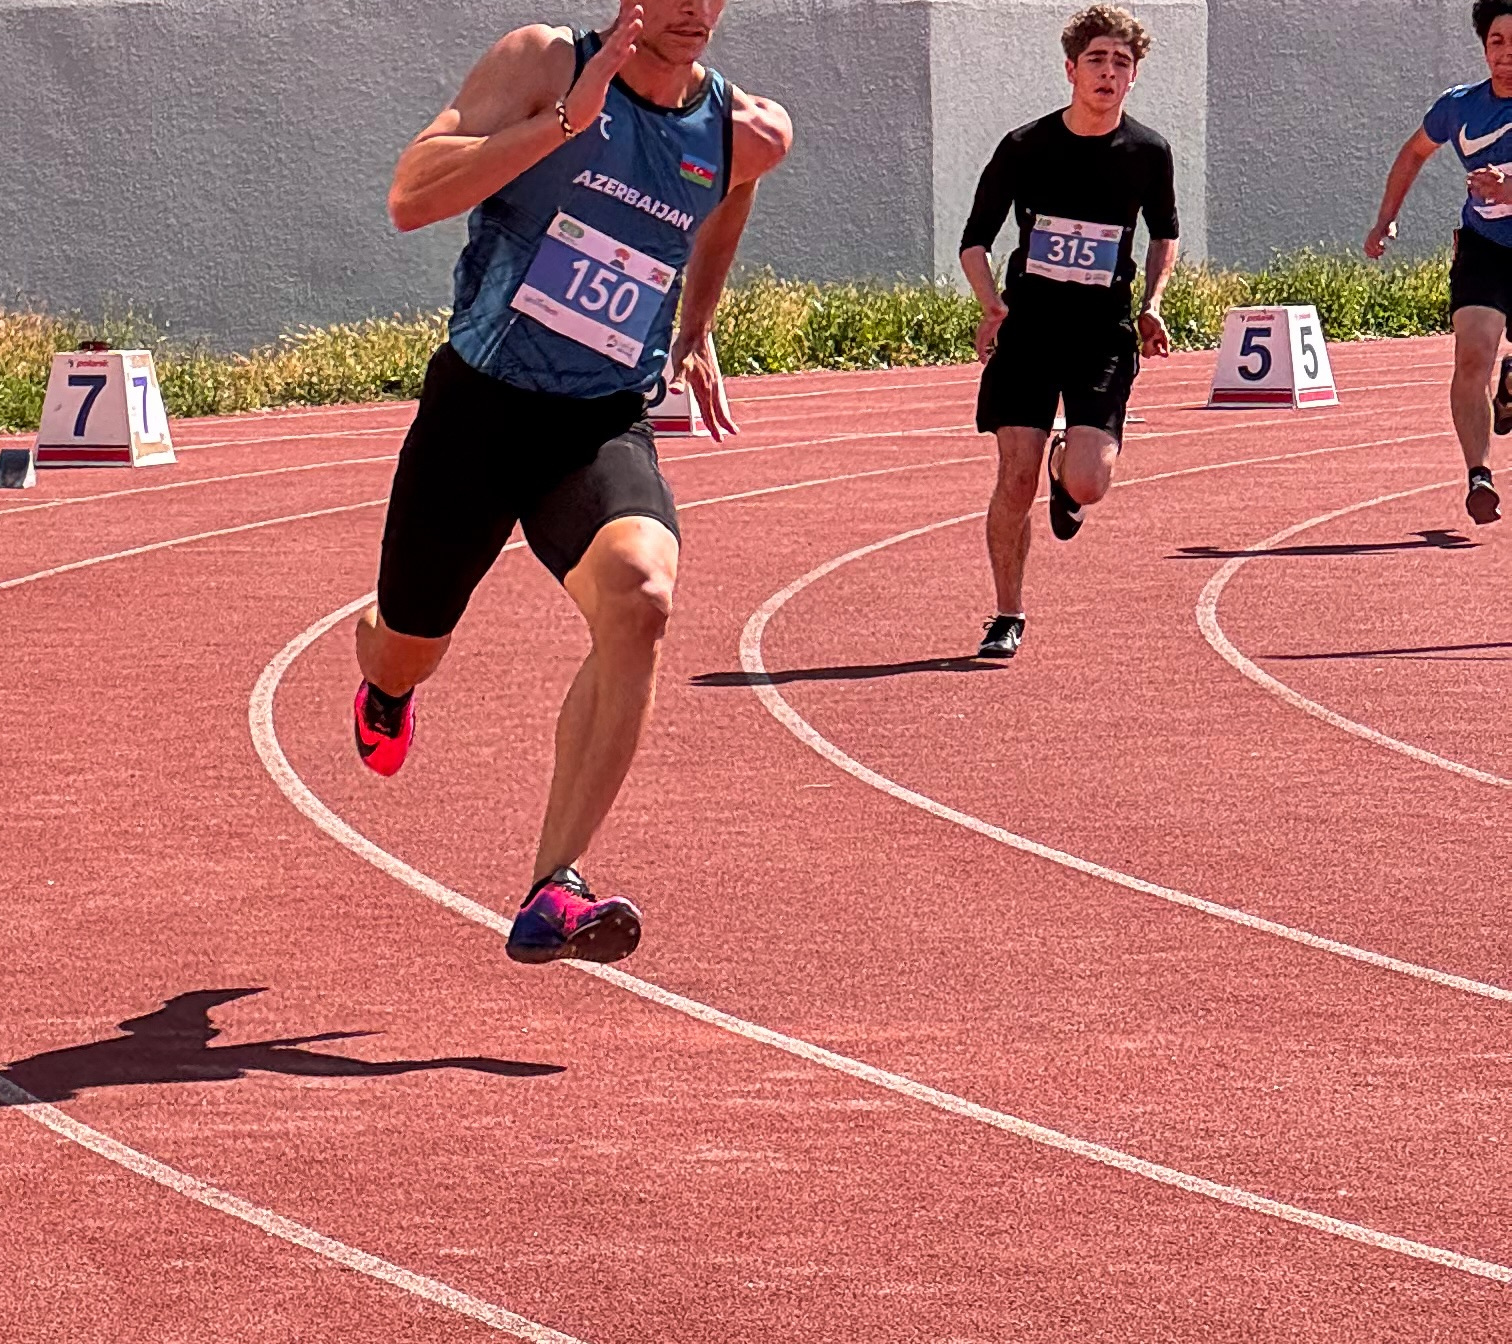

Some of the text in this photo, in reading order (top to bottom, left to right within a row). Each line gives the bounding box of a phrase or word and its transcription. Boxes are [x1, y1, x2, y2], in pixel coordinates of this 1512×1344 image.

[572, 169, 694, 231] AZERBAIJAN
[1047, 235, 1098, 266] 315
[565, 259, 640, 323] 150
[1238, 326, 1272, 381] 5
[1299, 326, 1319, 380] 5
[68, 374, 107, 437] 7
[132, 376, 148, 433] 7
